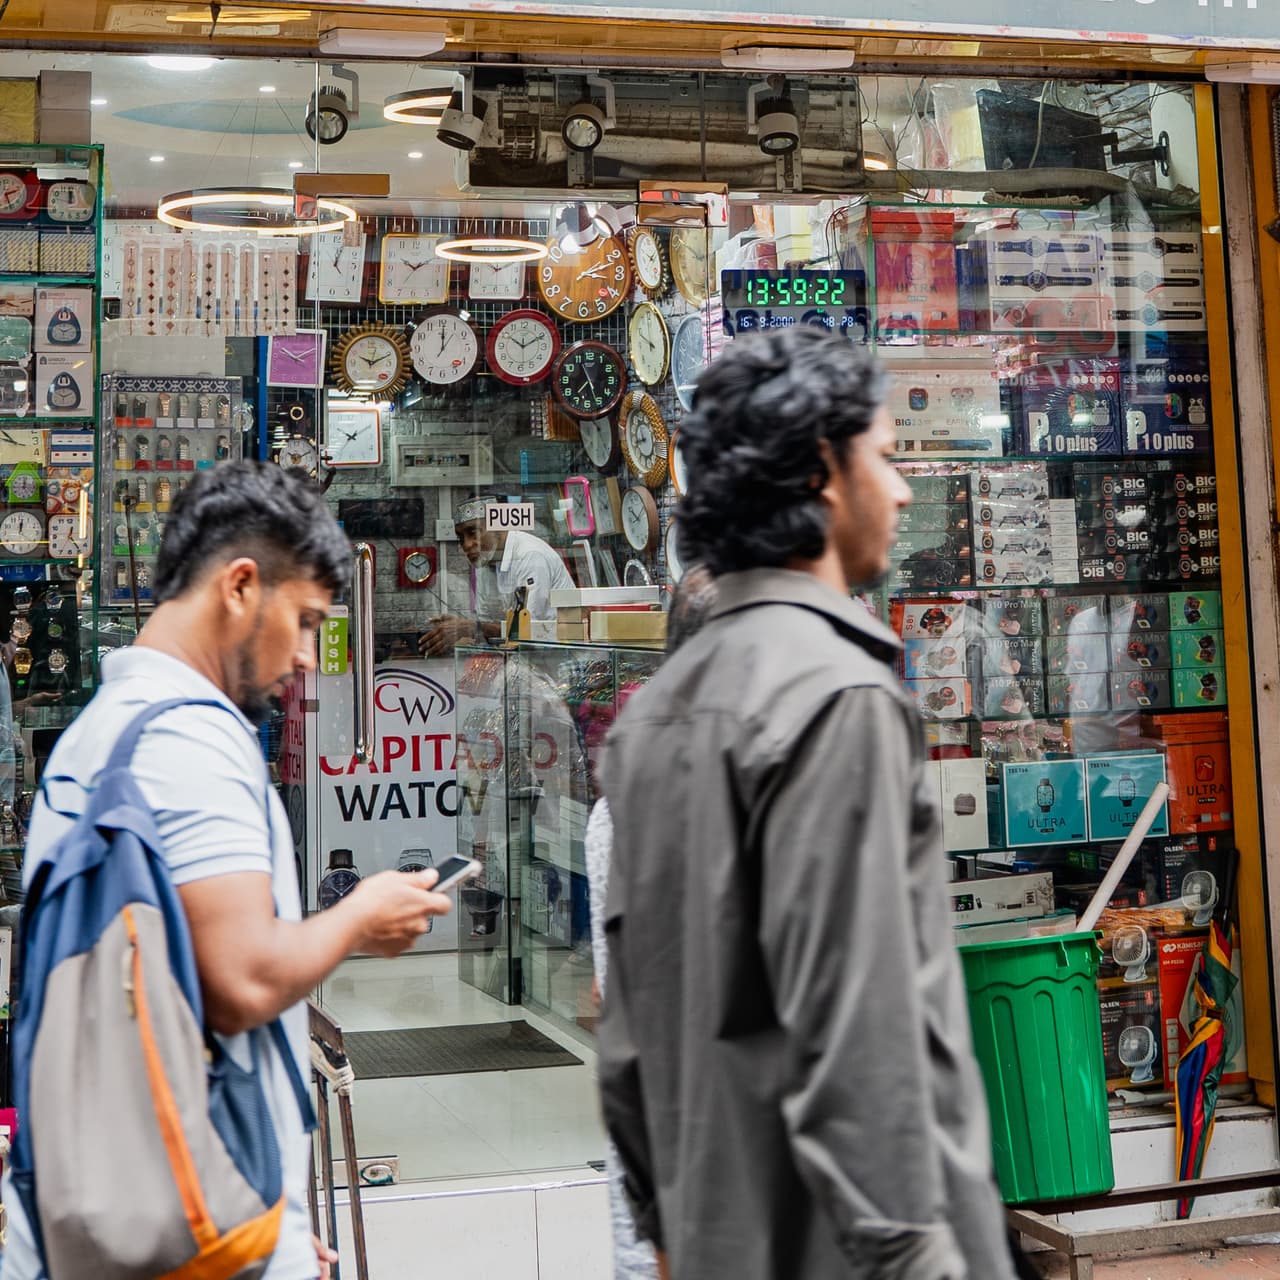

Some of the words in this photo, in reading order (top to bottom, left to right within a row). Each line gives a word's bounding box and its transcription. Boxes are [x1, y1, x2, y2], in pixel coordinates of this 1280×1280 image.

[746, 278, 846, 306] 13:59:22
[488, 507, 532, 528] PUSH
[327, 621, 340, 673] PUSH
[1187, 783, 1227, 798] ULTRA
